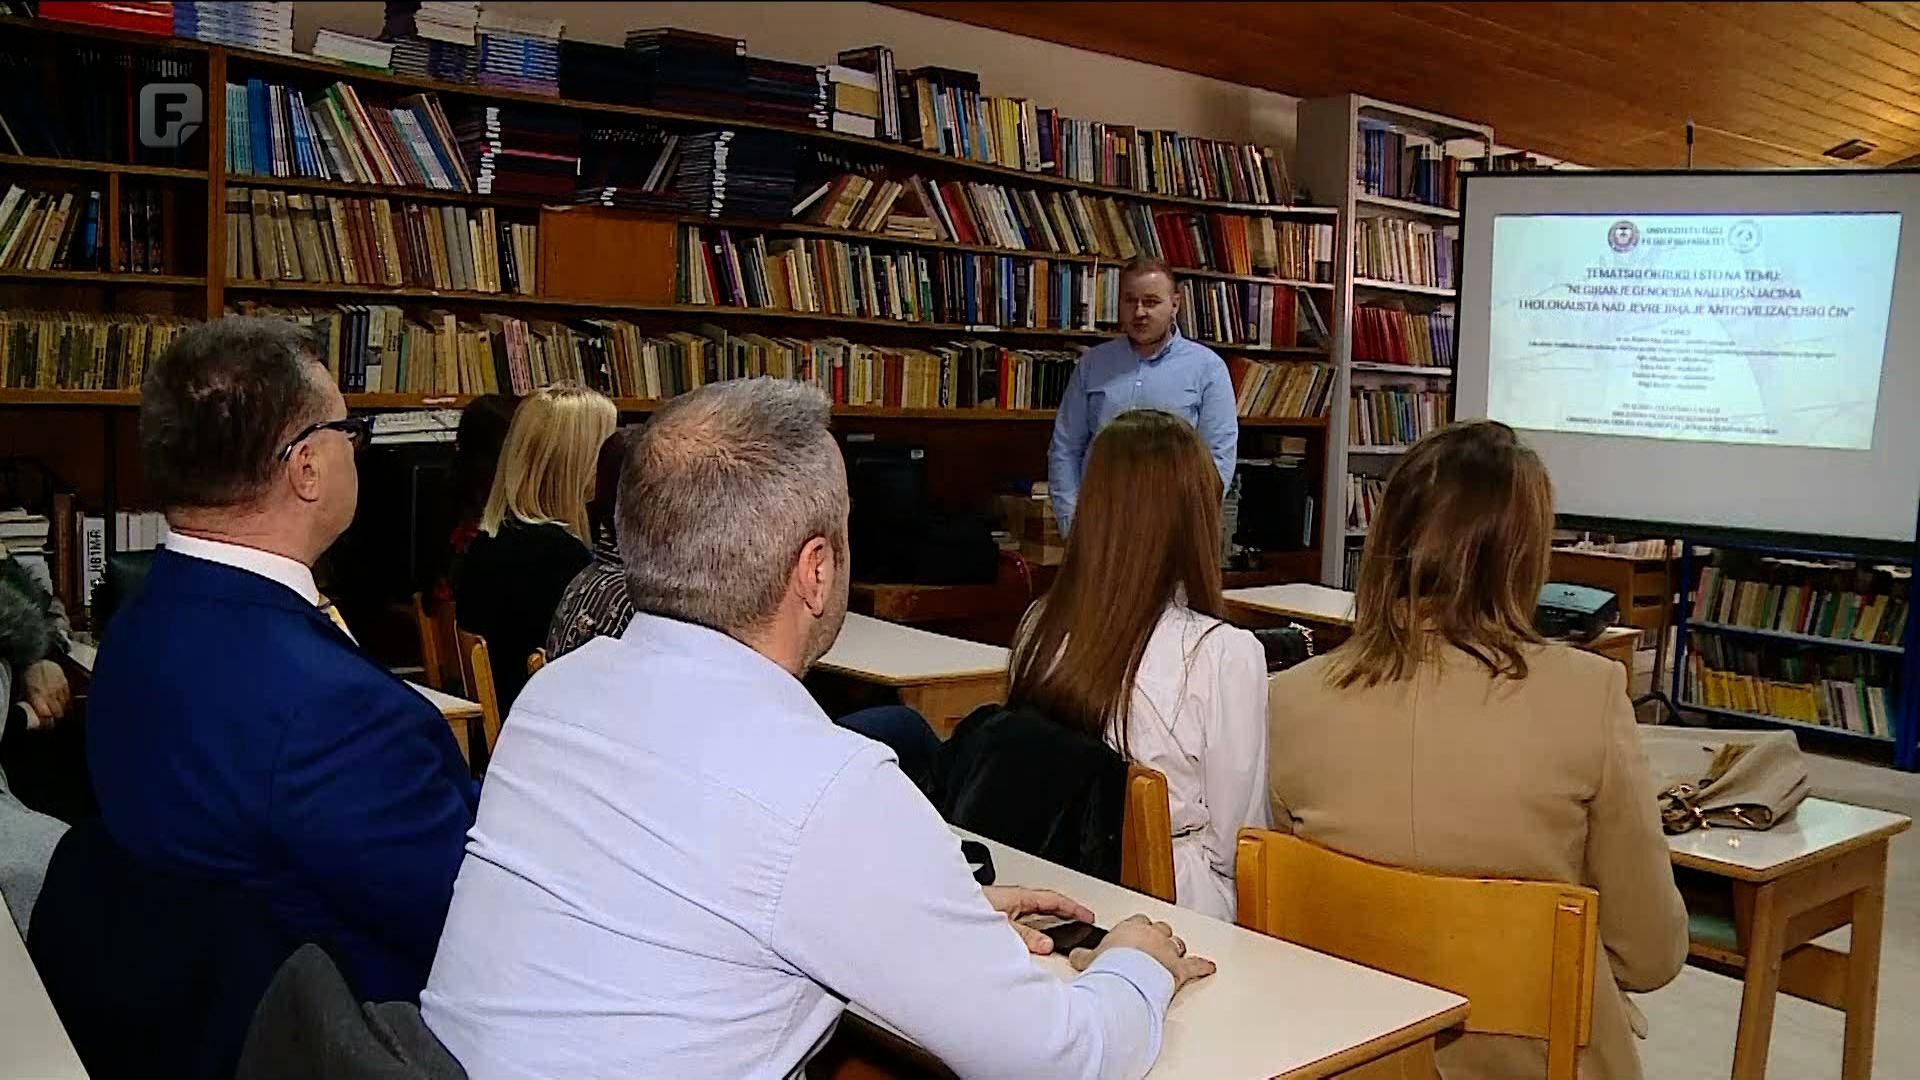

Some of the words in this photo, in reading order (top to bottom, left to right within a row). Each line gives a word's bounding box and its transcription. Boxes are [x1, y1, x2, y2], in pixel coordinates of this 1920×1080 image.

[1586, 267, 1643, 280] TEMATSKI
[1632, 285, 1692, 297] GENOCIDA
[1601, 302, 1626, 312] NAD
